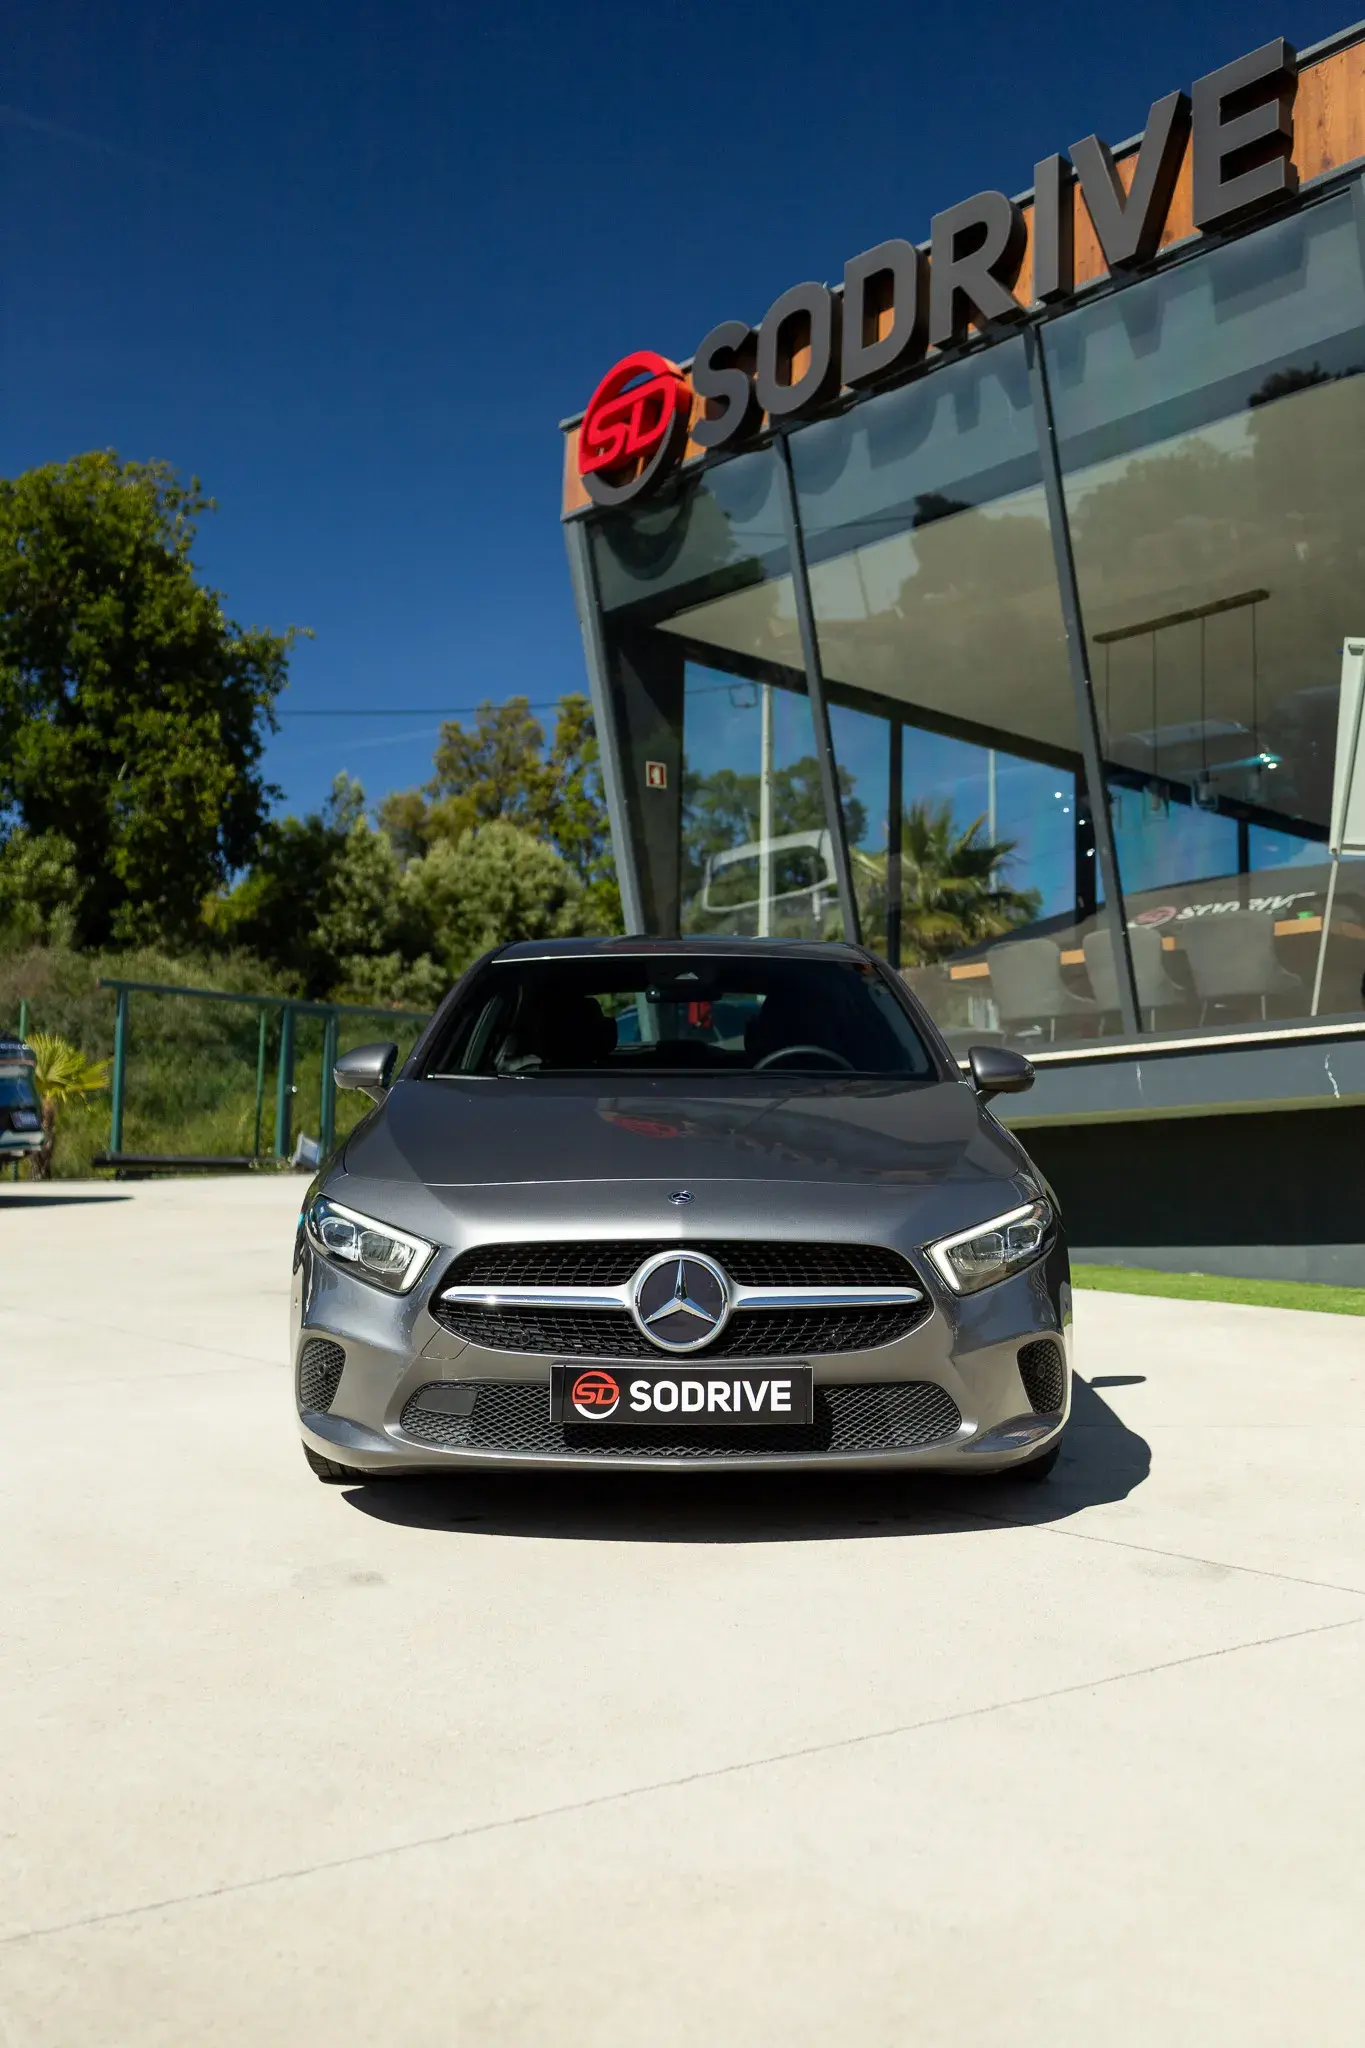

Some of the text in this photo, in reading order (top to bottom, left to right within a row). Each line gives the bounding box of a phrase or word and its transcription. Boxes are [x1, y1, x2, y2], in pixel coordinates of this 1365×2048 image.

[579, 36, 1299, 475] SD SODRIVE
[629, 1379, 792, 1413] SODRIVE
